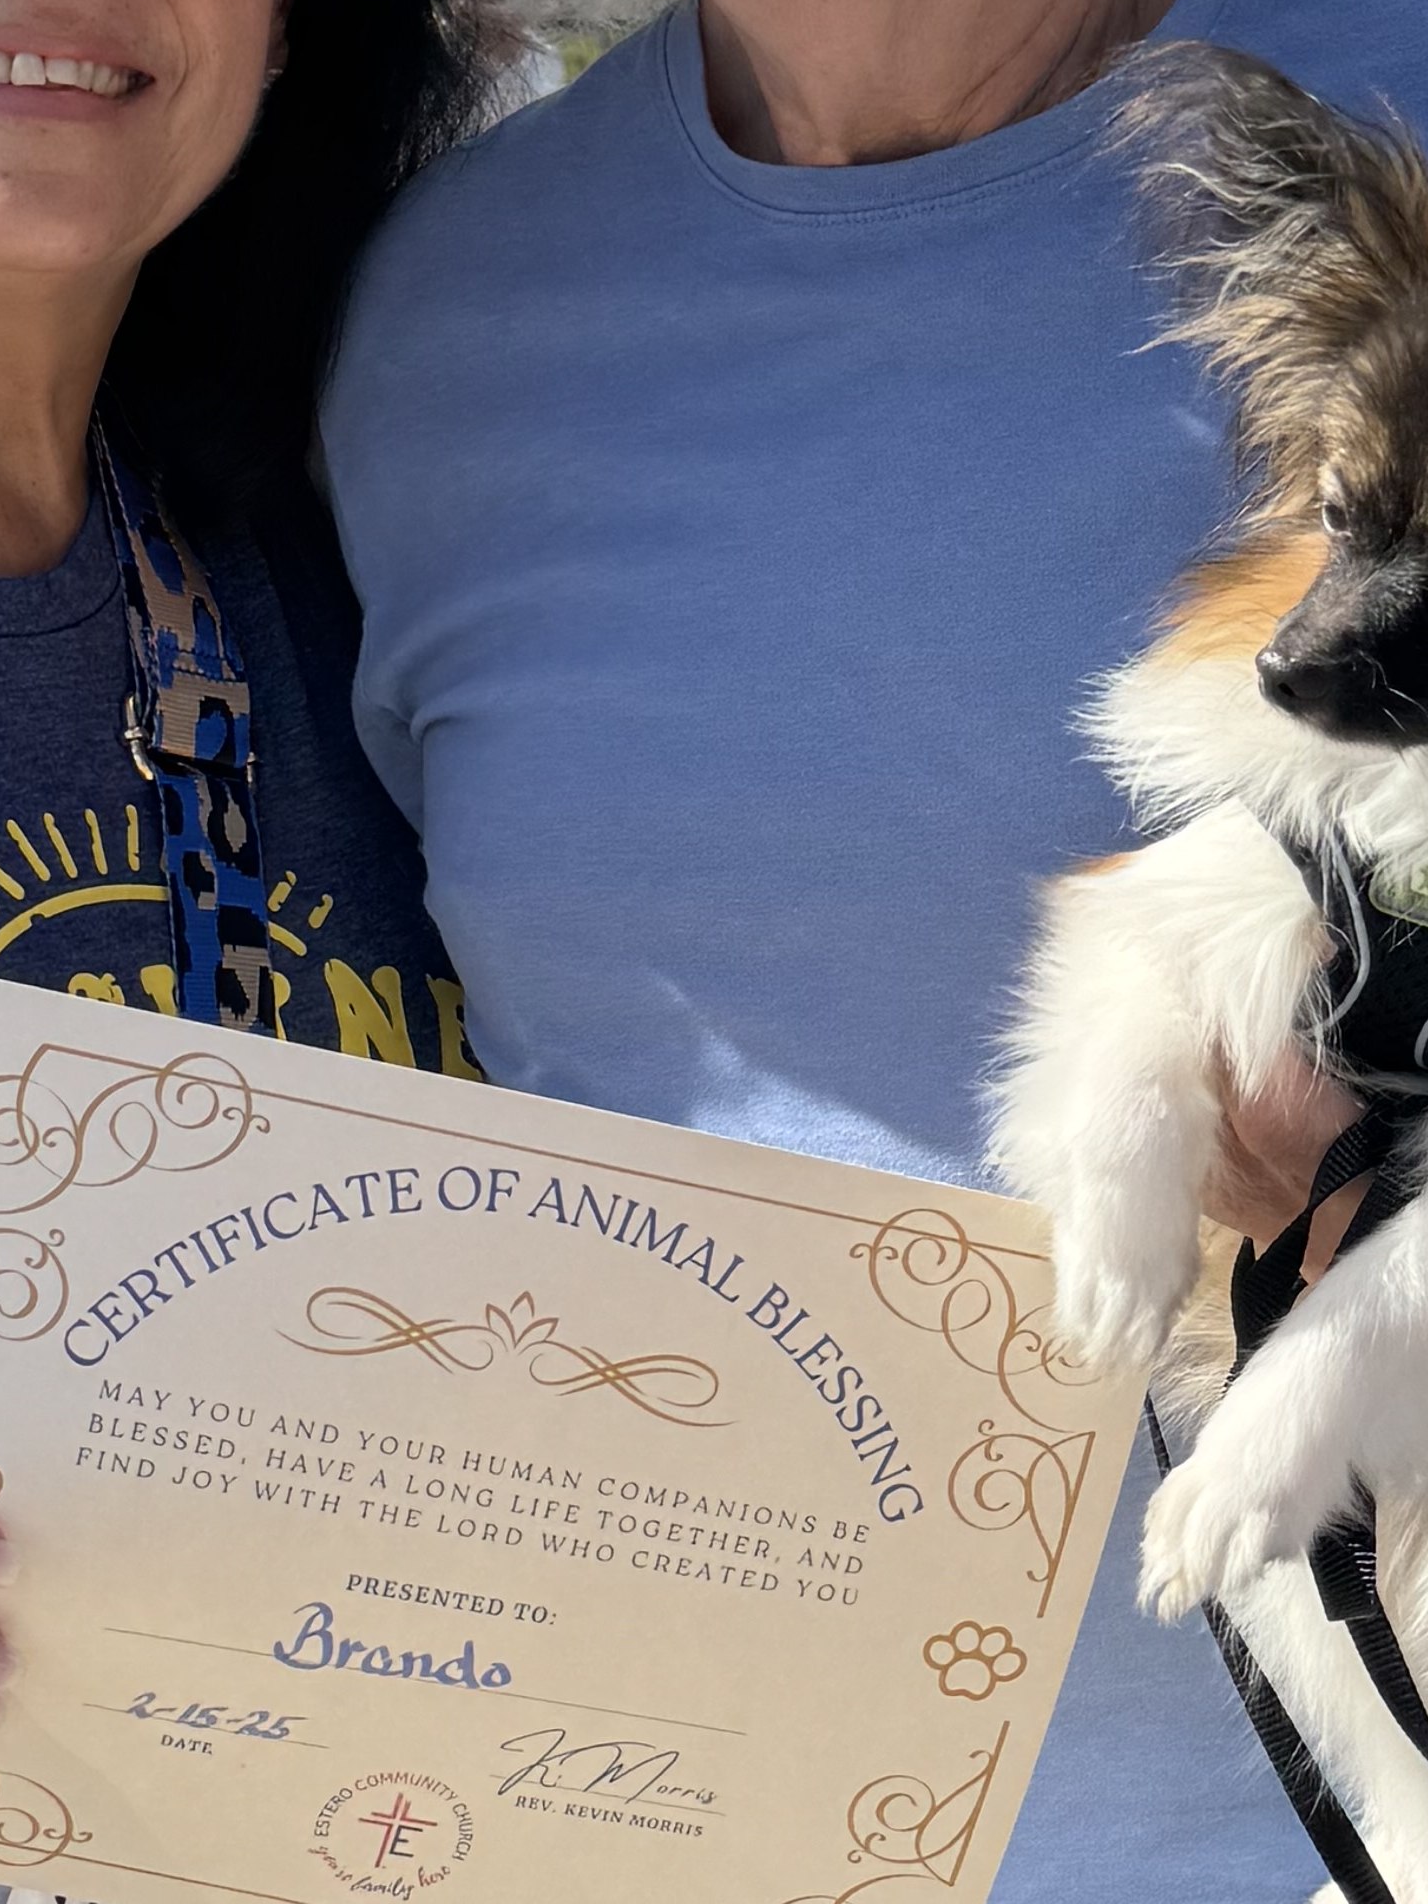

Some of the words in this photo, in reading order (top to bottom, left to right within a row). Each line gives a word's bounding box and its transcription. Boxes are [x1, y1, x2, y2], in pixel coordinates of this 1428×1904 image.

[63, 1166, 423, 1367] CERTIFICATE
[437, 1165, 521, 1213] OF
[527, 1177, 745, 1304] ANIMAL
[745, 1281, 925, 1524] BLESSING
[87, 1412, 248, 1466] BLESSED,
[265, 1447, 356, 1483] HAVE
[369, 1468, 388, 1490] A
[404, 1474, 495, 1508] LONG
[509, 1493, 582, 1525] LIFE
[596, 1509, 782, 1564] TOGETHER,
[796, 1547, 864, 1576] AND
[97, 1378, 172, 1412] MAY
[188, 1395, 257, 1428] YOU
[270, 1414, 340, 1445] AND
[357, 1429, 447, 1466] YOUR
[461, 1449, 583, 1490] HUMAN
[596, 1476, 817, 1535] COMPANIONS
[832, 1520, 871, 1544] BE
[74, 1446, 157, 1479] FIND
[171, 1465, 239, 1495] JOY
[253, 1479, 342, 1514] WITH
[358, 1499, 423, 1529] THE
[436, 1514, 524, 1547] LORD
[540, 1532, 616, 1563] WHO
[630, 1550, 780, 1592] CREATED
[796, 1578, 860, 1607] YOU
[344, 1573, 505, 1617] PRESENTED
[513, 1601, 559, 1626] TO:
[272, 1601, 513, 1690] Brando
[125, 1691, 309, 1741] 2-15-25
[160, 1734, 213, 1756] DATE
[314, 1787, 354, 1838] ESTERO
[354, 1771, 459, 1802] COMMUNITY
[451, 1802, 474, 1862] CHURCH
[514, 1795, 557, 1814] REV.
[563, 1803, 624, 1824] KEVIN
[628, 1814, 704, 1837] MORRIS
